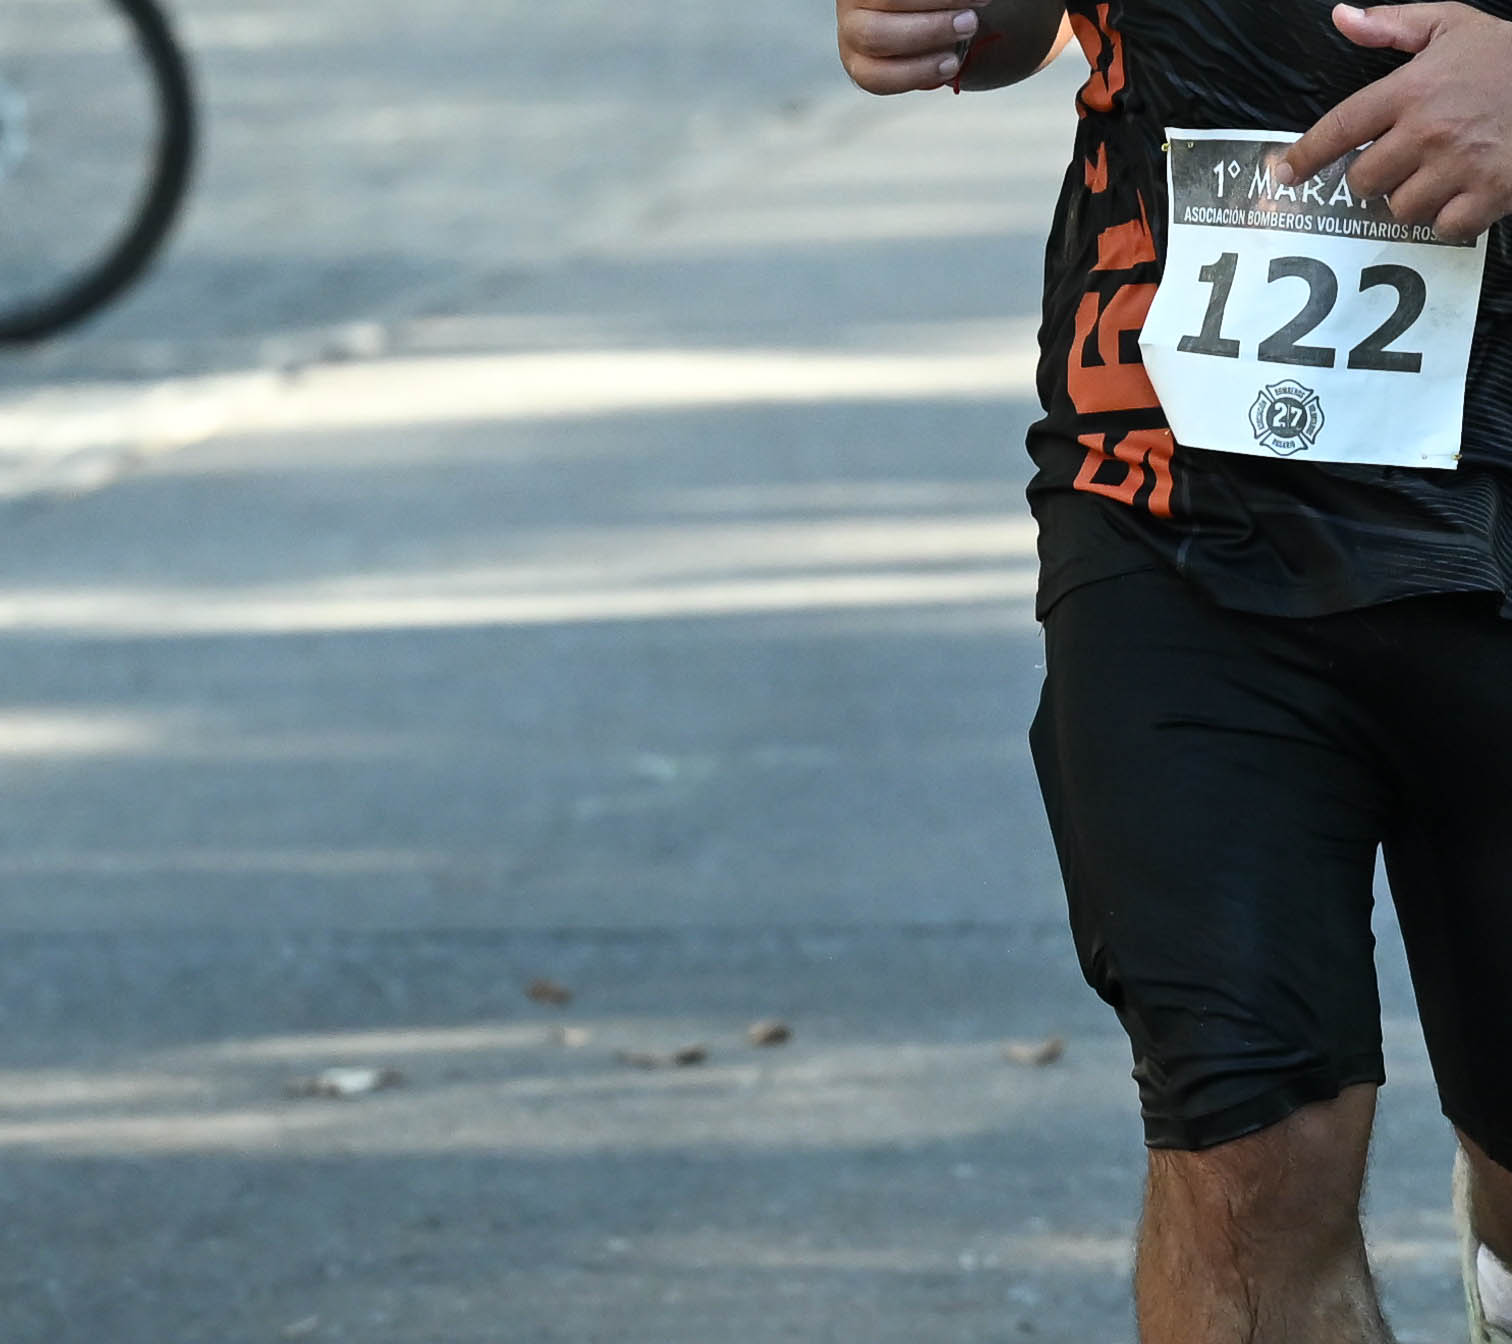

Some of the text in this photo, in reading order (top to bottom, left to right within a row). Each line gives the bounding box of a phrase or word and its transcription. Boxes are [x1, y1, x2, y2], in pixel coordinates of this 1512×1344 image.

[1184, 205, 1245, 225] ASOCIACIÓN
[1247, 210, 1313, 231] BOMBEROS
[1317, 216, 1409, 240] VOLUNTARIOS
[1177, 252, 1426, 373] 122
[1272, 402, 1303, 427] 27
